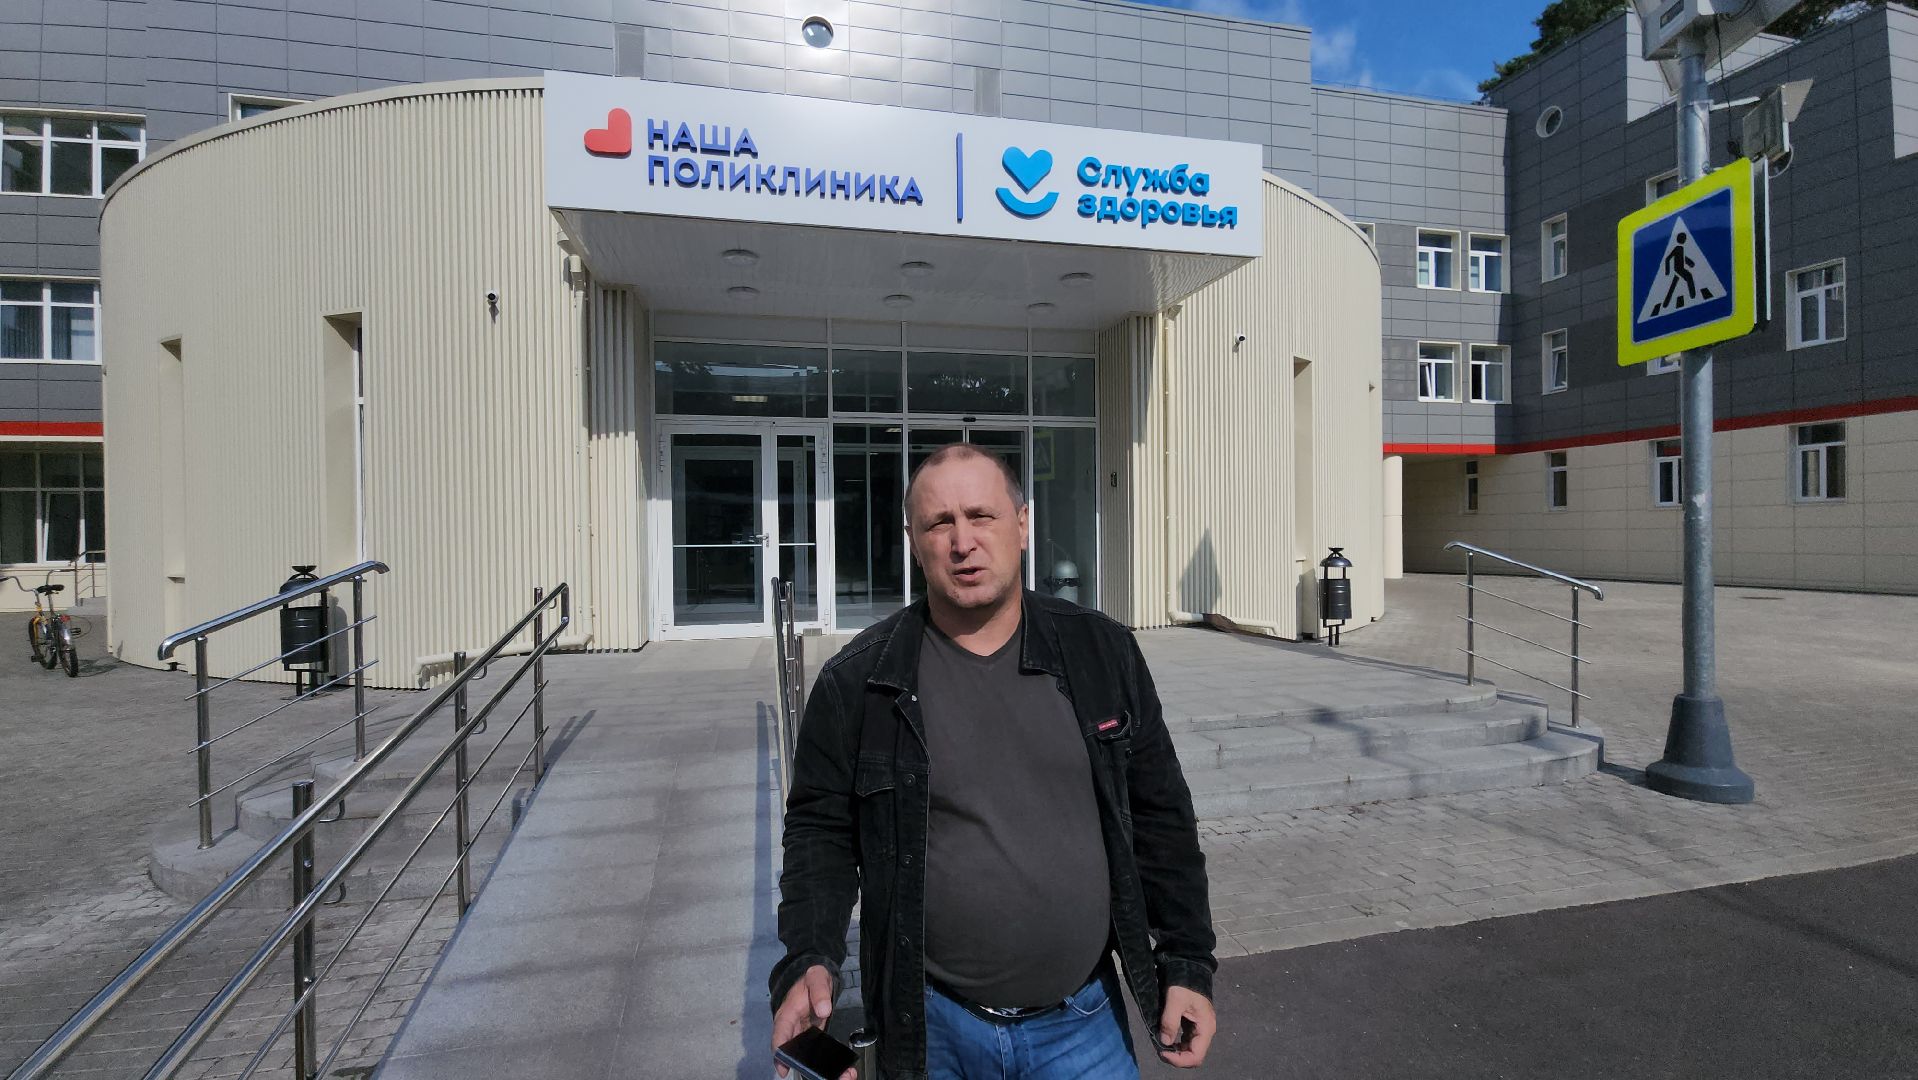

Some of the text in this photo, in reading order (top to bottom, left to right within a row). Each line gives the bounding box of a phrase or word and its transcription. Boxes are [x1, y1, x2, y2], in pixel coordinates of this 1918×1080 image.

[648, 118, 758, 159] НАША
[648, 155, 923, 206] ПОЛИКЛИНИКА
[1077, 156, 1210, 196] Служба
[1077, 194, 1237, 229] здоровья
